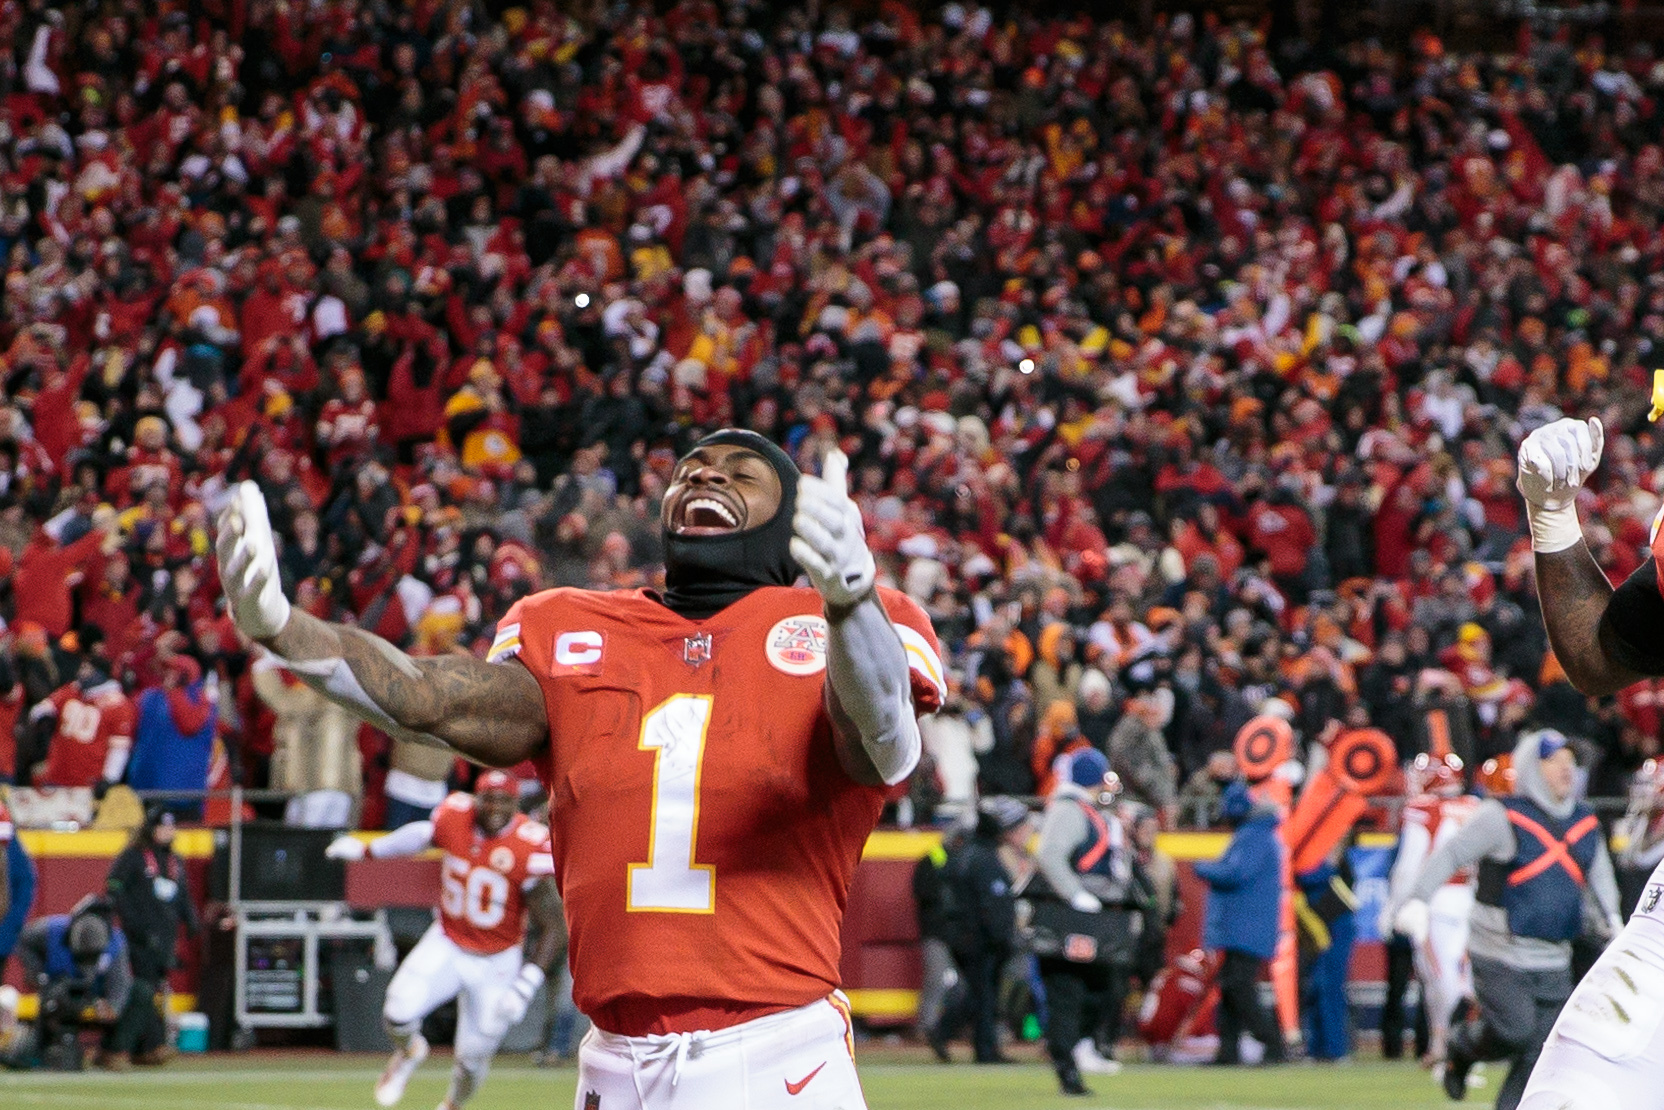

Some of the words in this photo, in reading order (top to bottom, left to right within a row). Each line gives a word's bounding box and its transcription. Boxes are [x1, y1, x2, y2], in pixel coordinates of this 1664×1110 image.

[555, 630, 603, 666] C
[625, 692, 716, 914] 1
[441, 854, 510, 929] 50
